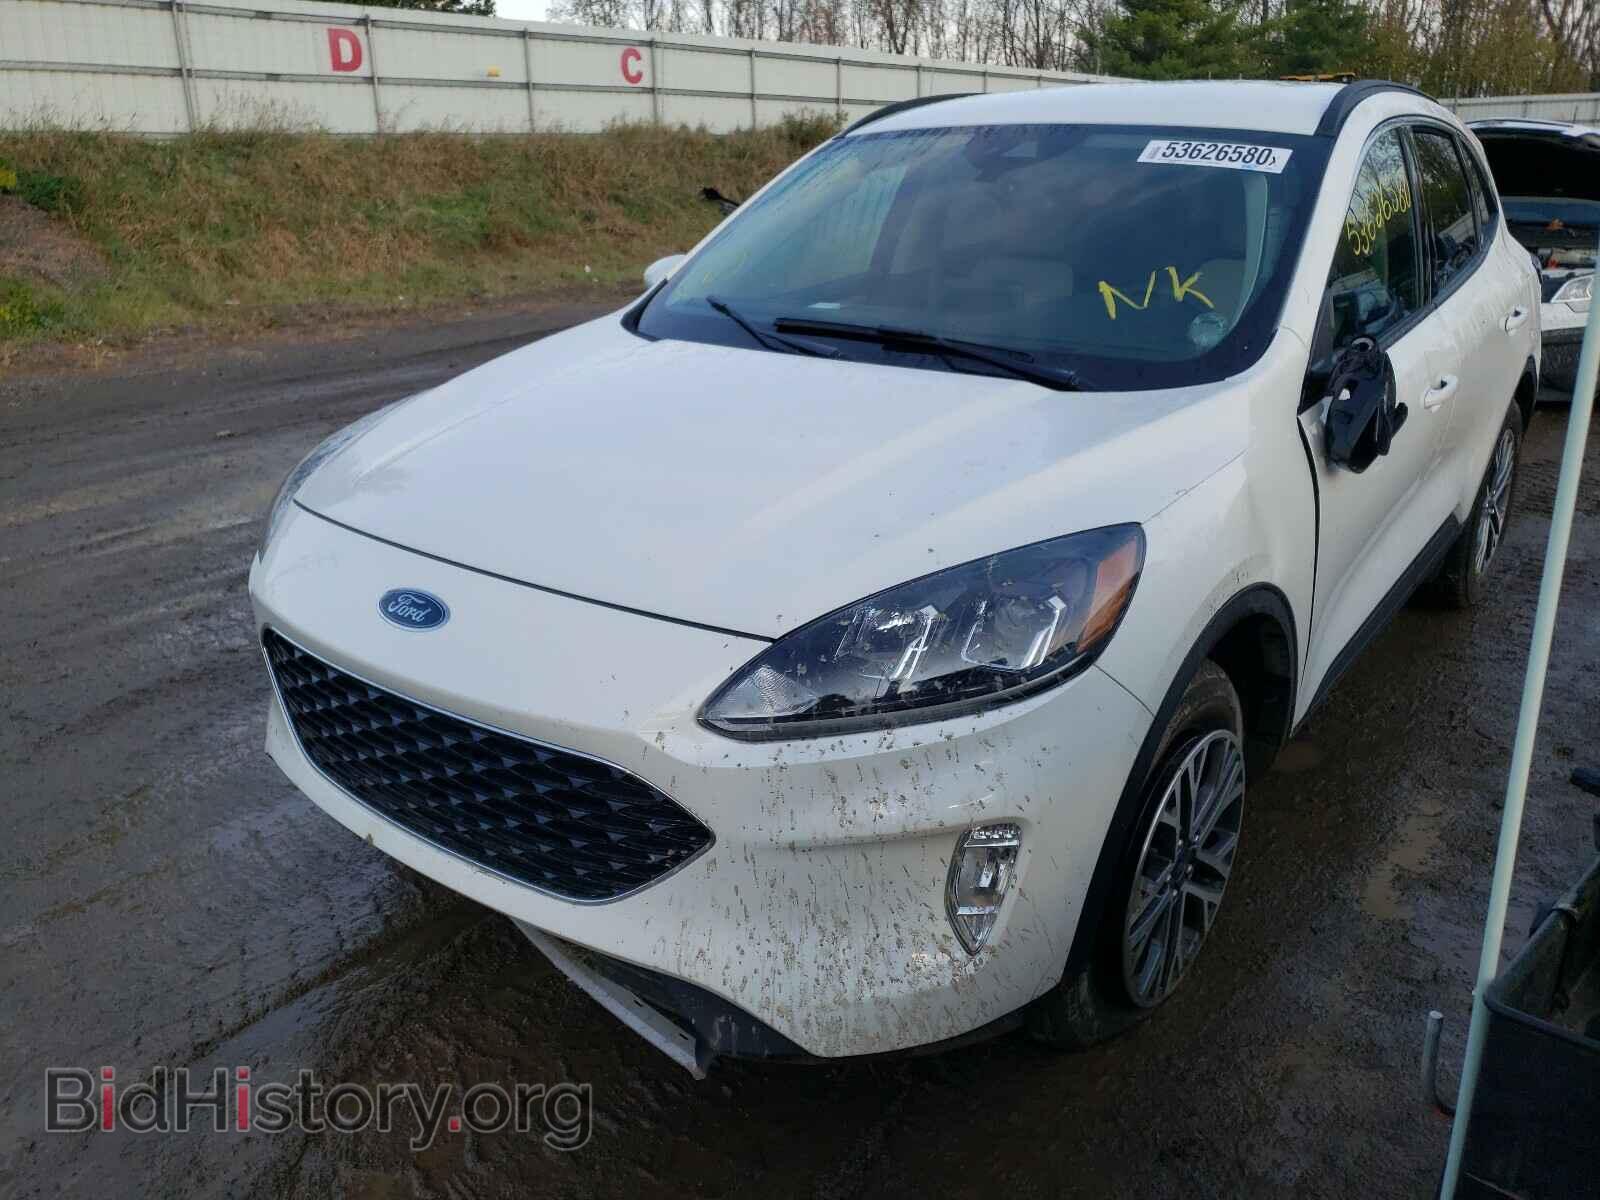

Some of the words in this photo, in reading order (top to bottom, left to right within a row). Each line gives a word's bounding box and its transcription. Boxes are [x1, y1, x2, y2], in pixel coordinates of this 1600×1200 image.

[327, 27, 363, 73] D
[620, 47, 645, 85] C
[387, 593, 432, 622] Ford
